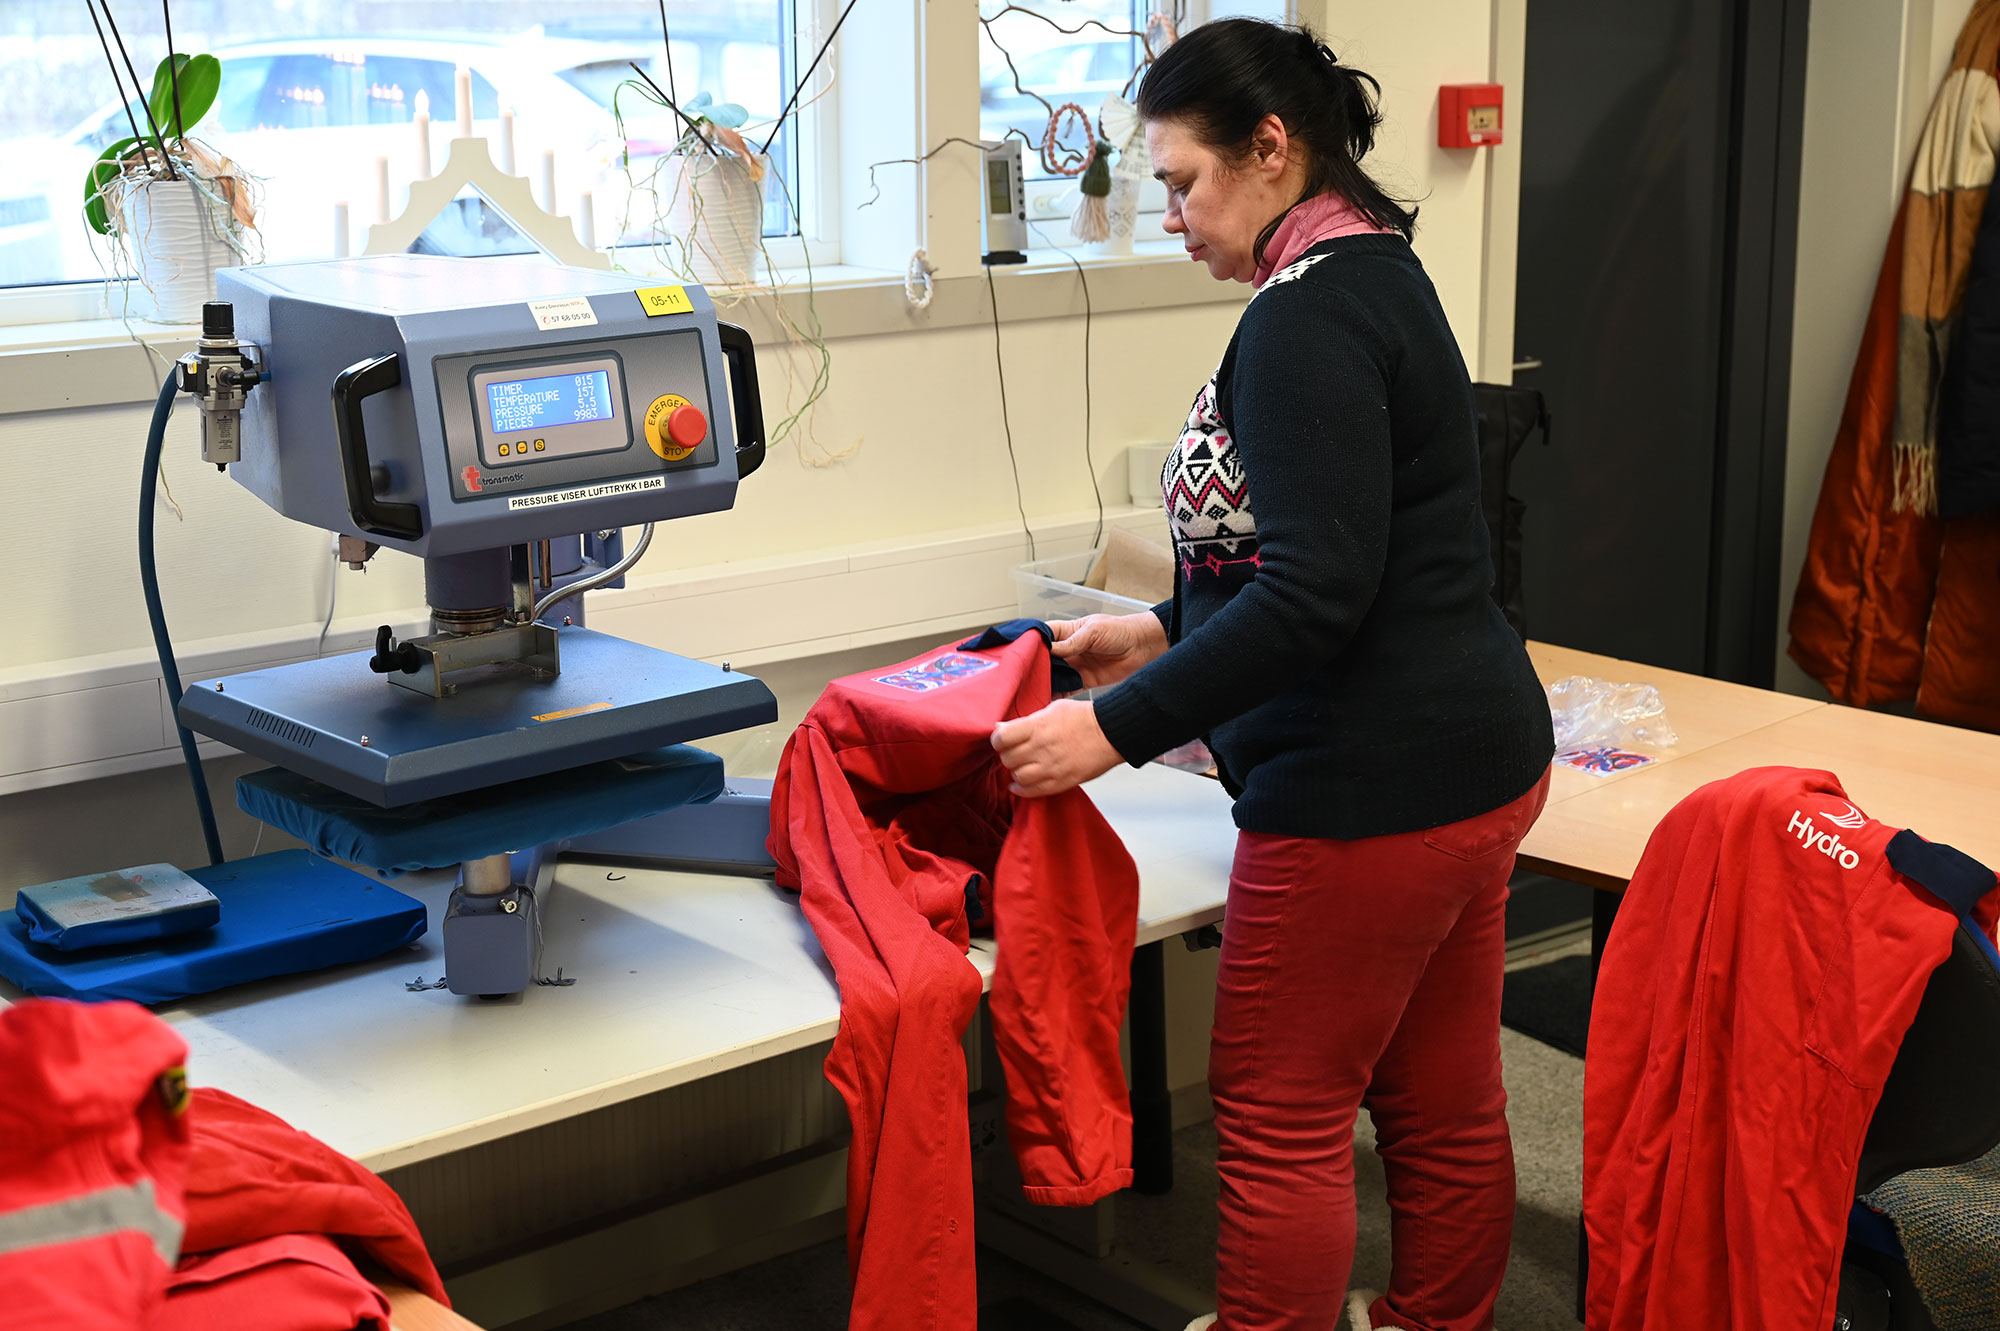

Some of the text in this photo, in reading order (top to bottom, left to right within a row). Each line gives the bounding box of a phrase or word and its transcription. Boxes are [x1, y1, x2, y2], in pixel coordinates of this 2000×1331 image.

[650, 295, 680, 307] 05-11
[551, 315, 560, 323] 57
[561, 314, 571, 322] 68
[571, 313, 581, 321] 05
[492, 375, 593, 397] TIMER 015
[494, 386, 594, 408] TEMPERATURE 157
[495, 397, 597, 420] PRESSURE 5.5
[648, 398, 684, 426] EMERGE
[497, 416, 534, 431] PIECES
[482, 472, 524, 485] transmatic
[512, 494, 559, 507] PRESSURE
[560, 490, 586, 501] VISER
[588, 482, 637, 497] LUFTTRYKK
[643, 479, 661, 489] BAR
[1787, 810, 1859, 869] Hydro
